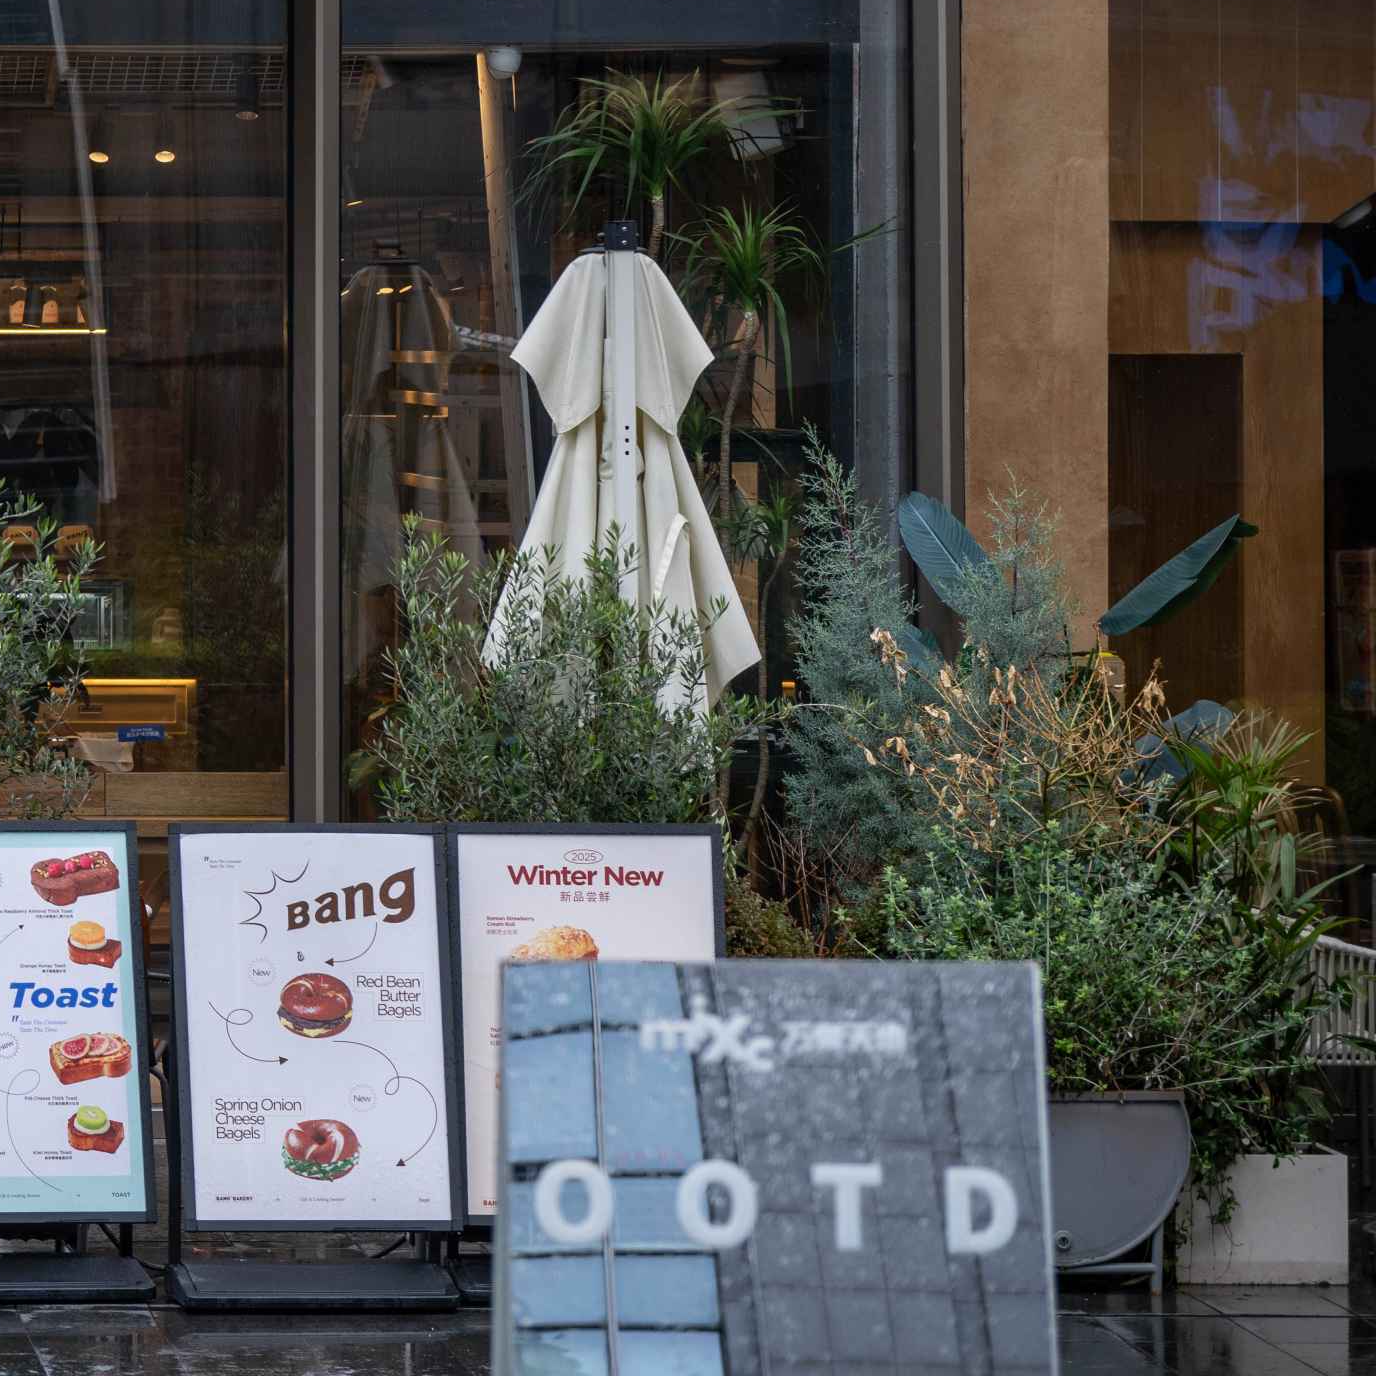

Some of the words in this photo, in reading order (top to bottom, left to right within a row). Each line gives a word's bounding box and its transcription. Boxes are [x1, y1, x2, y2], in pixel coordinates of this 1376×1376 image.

[570, 851, 596, 862] 2025
[507, 864, 598, 886] Winter
[604, 864, 664, 887] New
[285, 866, 416, 931] Bang
[559, 890, 610, 903] 新品尝鲜
[252, 968, 271, 978] New
[356, 975, 383, 988] Red
[386, 975, 421, 988] Bean
[9, 982, 118, 1009] Toast
[380, 989, 421, 1002] Butter
[377, 1003, 422, 1019] Bagels
[215, 1098, 258, 1113] Spring
[260, 1098, 302, 1111] Onion
[353, 1094, 371, 1103] New
[215, 1112, 265, 1125] Cheese
[216, 1126, 260, 1142] Bagels
[534, 1159, 1019, 1254] OOTD
